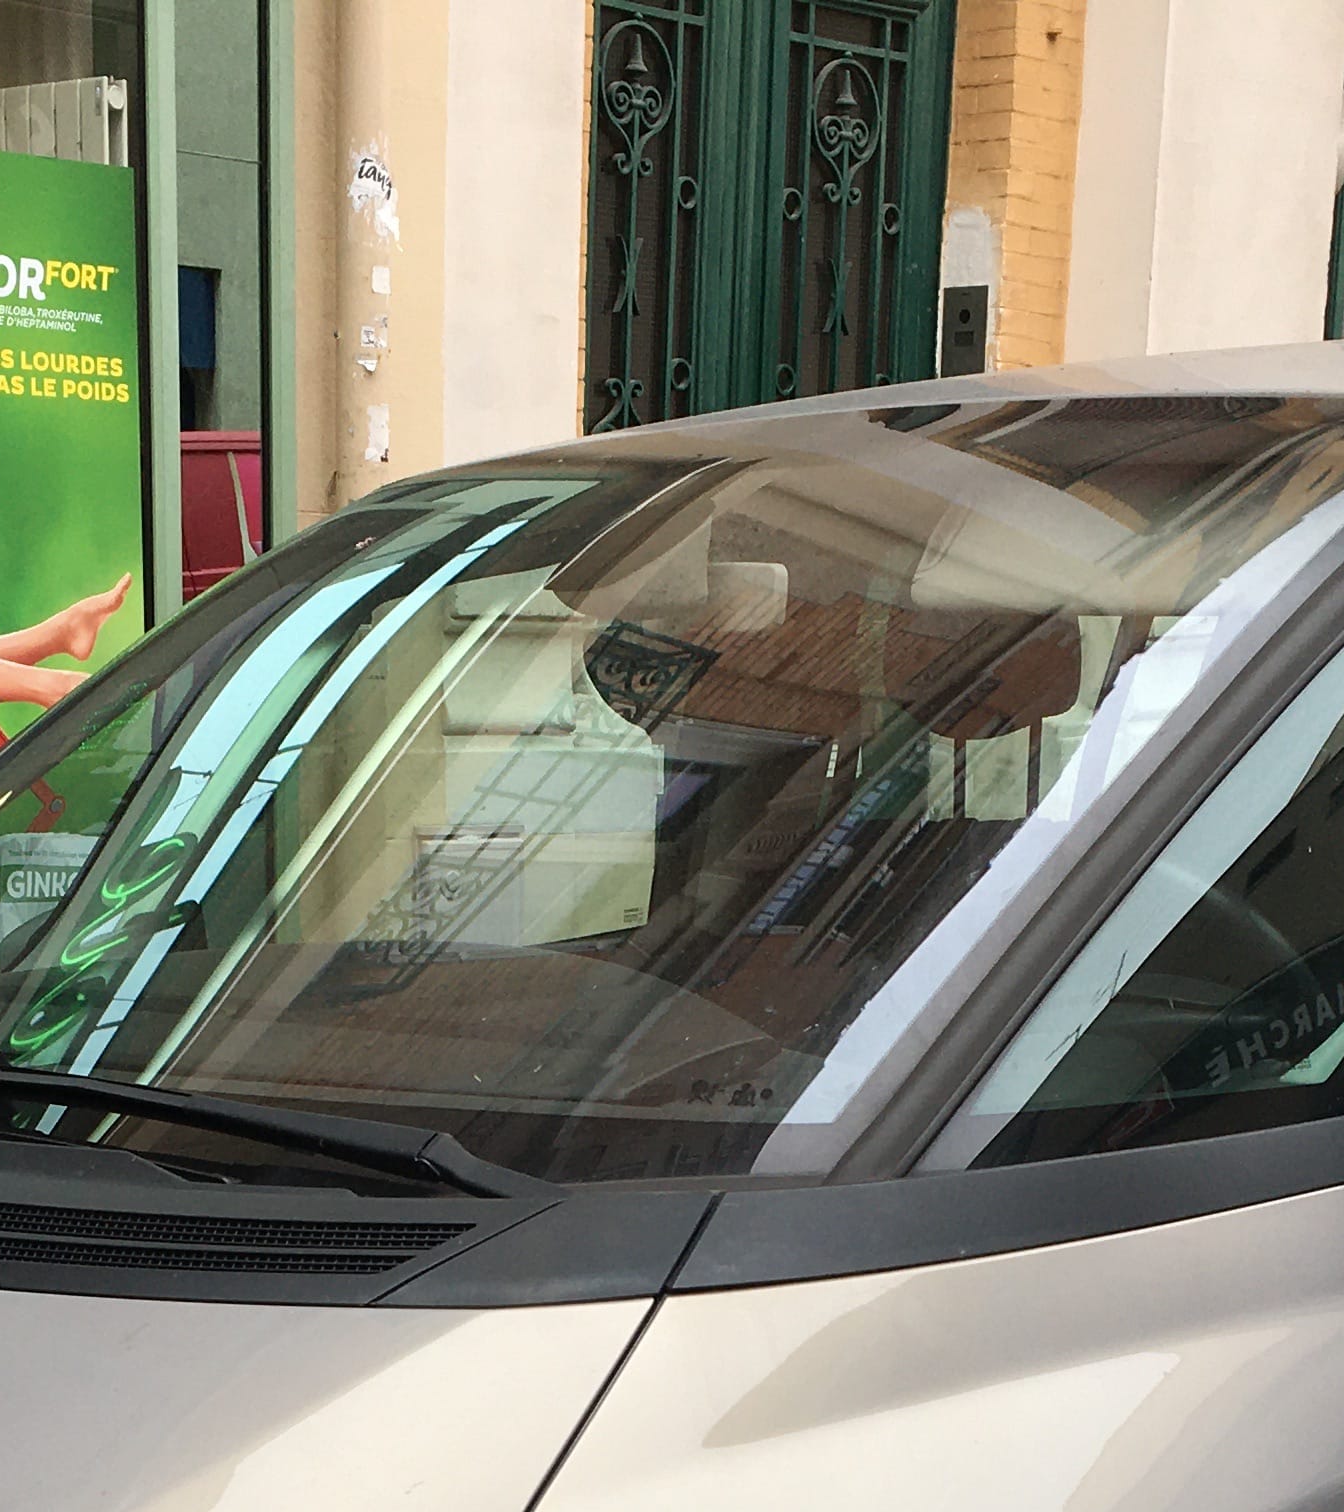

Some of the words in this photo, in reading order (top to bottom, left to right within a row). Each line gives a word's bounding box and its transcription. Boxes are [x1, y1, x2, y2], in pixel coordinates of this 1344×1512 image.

[45, 259, 115, 292] FORT
[6, 316, 77, 333] D'HEPTAMINOL
[21, 350, 124, 378] LOURDES
[30, 376, 57, 398] LE
[62, 380, 130, 403] POIDS
